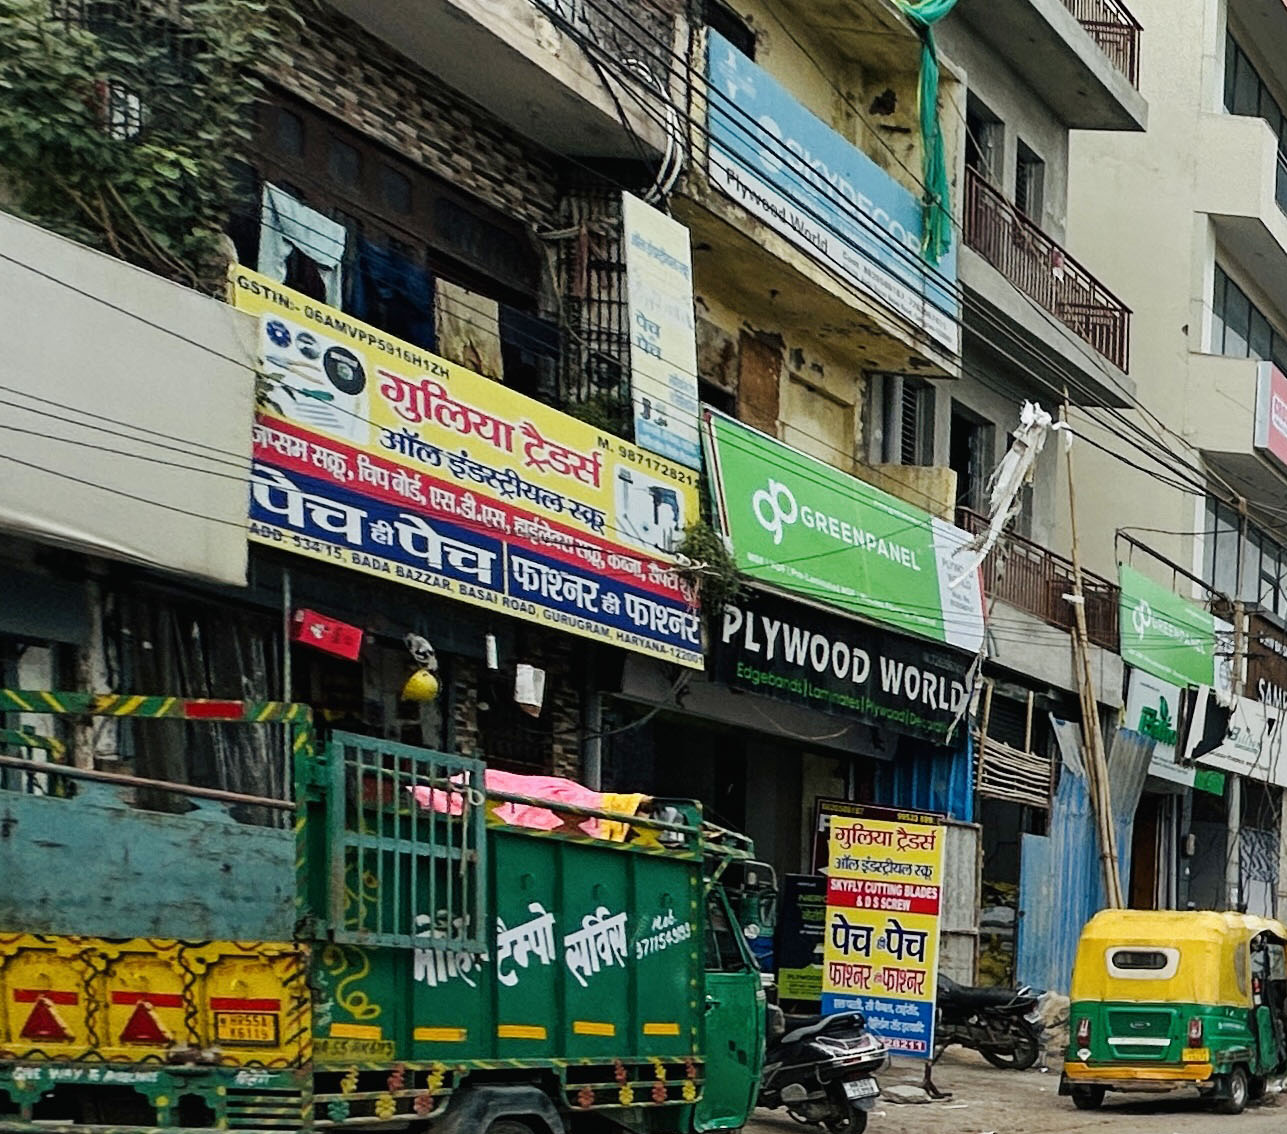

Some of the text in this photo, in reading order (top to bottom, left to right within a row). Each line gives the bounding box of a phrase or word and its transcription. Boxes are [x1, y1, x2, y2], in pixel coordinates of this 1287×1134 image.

[725, 167, 787, 225] Plywood
[787, 210, 830, 252] World
[377, 369, 516, 453] गुलिया
[379, 426, 442, 467] ऑल
[449, 449, 564, 514] इंडस्ट्रीयल
[597, 436, 615, 453] M.
[251, 462, 497, 585] पेच ही पेच
[800, 505, 921, 571] GREENPANEL
[351, 553, 391, 574] BADA
[395, 565, 455, 594] BAZZAR,
[459, 585, 499, 605] BASAI
[502, 592, 539, 617] ROAD,
[542, 605, 613, 640] GURUGRAM,
[510, 554, 600, 613] फाश्नर
[600, 593, 621, 616] ही
[721, 603, 871, 684] PLYWOOD
[880, 655, 968, 714] WORLD
[834, 823, 894, 849] गुलिया
[834, 854, 860, 871] ऑल
[829, 879, 939, 901] SKYFLY CUTTING BLADES
[880, 898, 912, 912] SCREW
[831, 913, 875, 958] पेच
[885, 918, 928, 963] पेच
[828, 960, 873, 990] फाश्नर
[882, 966, 927, 996] फाश्नर
